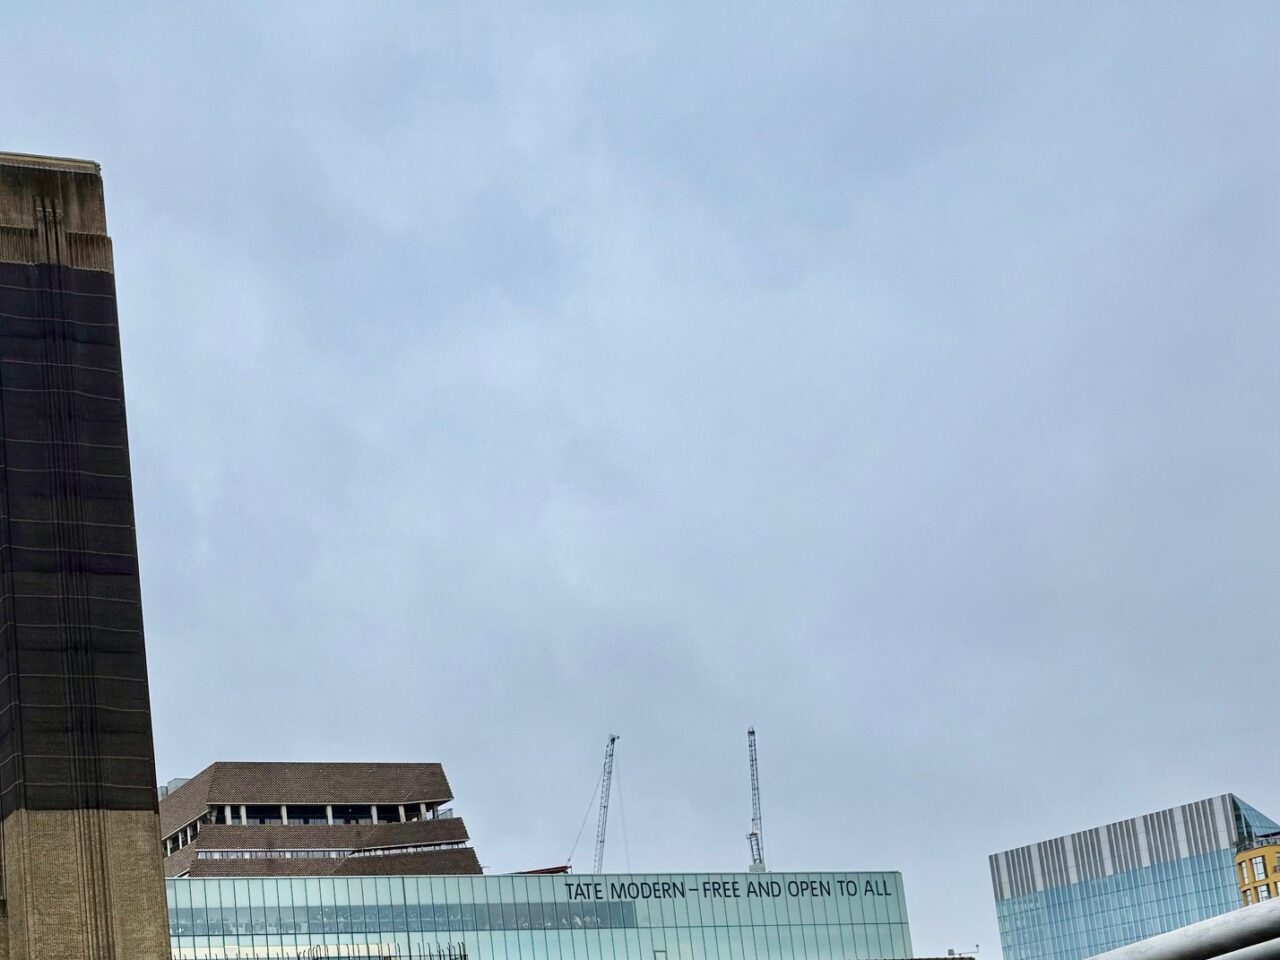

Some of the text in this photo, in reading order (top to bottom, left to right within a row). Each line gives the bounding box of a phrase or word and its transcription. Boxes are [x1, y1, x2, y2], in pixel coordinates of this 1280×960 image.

[565, 883, 603, 900] TATE
[610, 882, 686, 899] MODERN
[702, 881, 740, 898] FREE
[746, 881, 782, 898] AND
[787, 880, 831, 897] OPEN
[837, 880, 858, 897] TO
[864, 879, 892, 896] ALL
